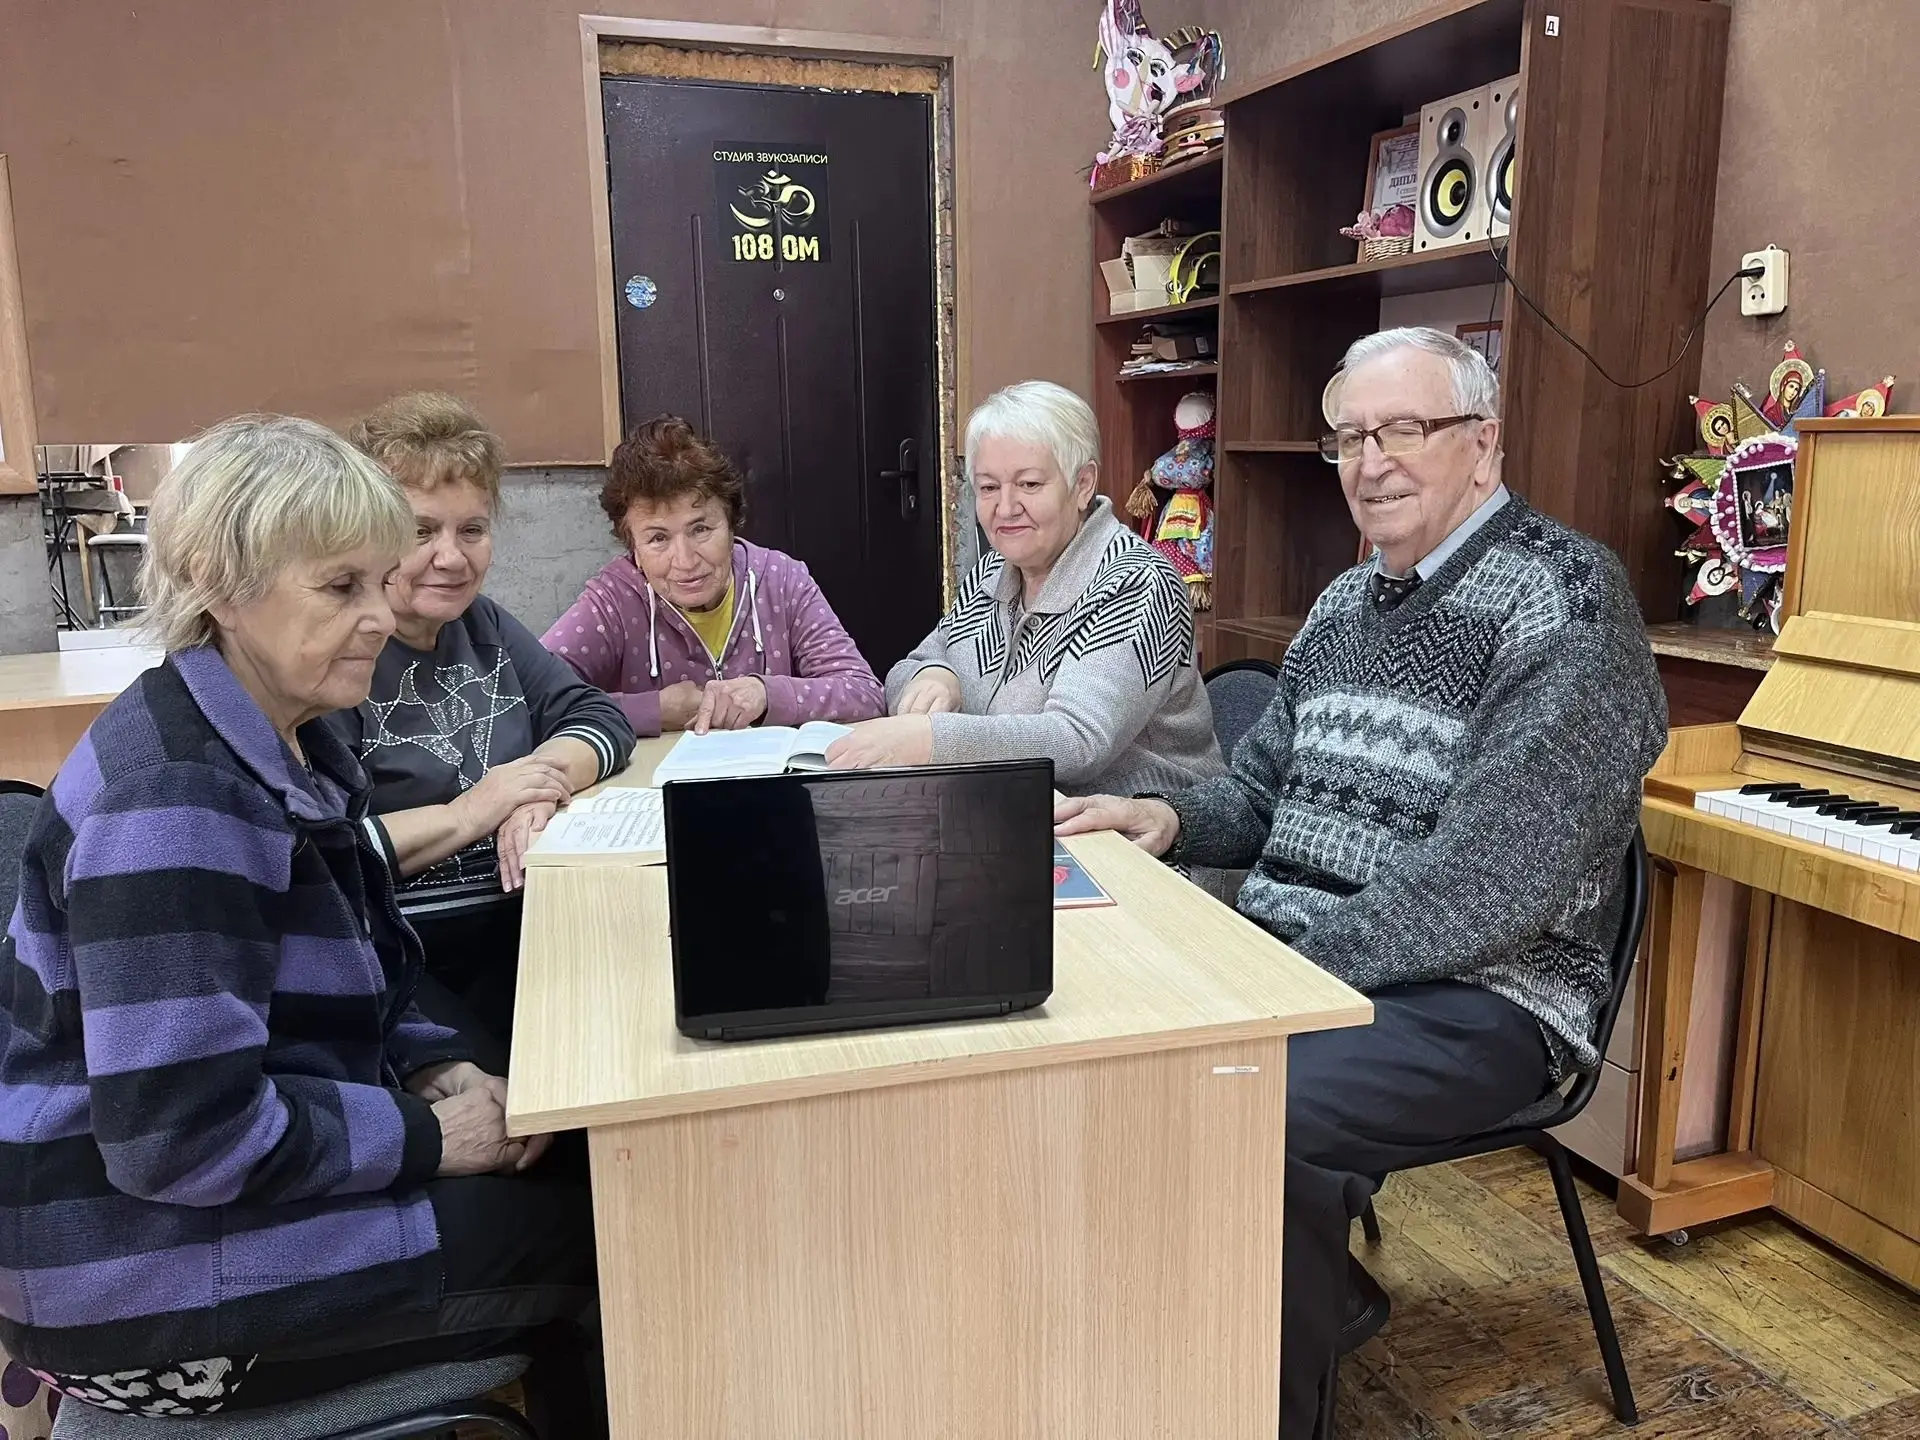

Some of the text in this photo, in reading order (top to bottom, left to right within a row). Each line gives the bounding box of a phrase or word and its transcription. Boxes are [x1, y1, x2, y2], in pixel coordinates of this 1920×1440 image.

[1547, 21, 1555, 34] Д
[713, 151, 828, 164] СТУДИЯ ЗВУКОЗАПИСИ
[732, 233, 820, 261] 108 ОМ
[834, 886, 899, 905] acer
